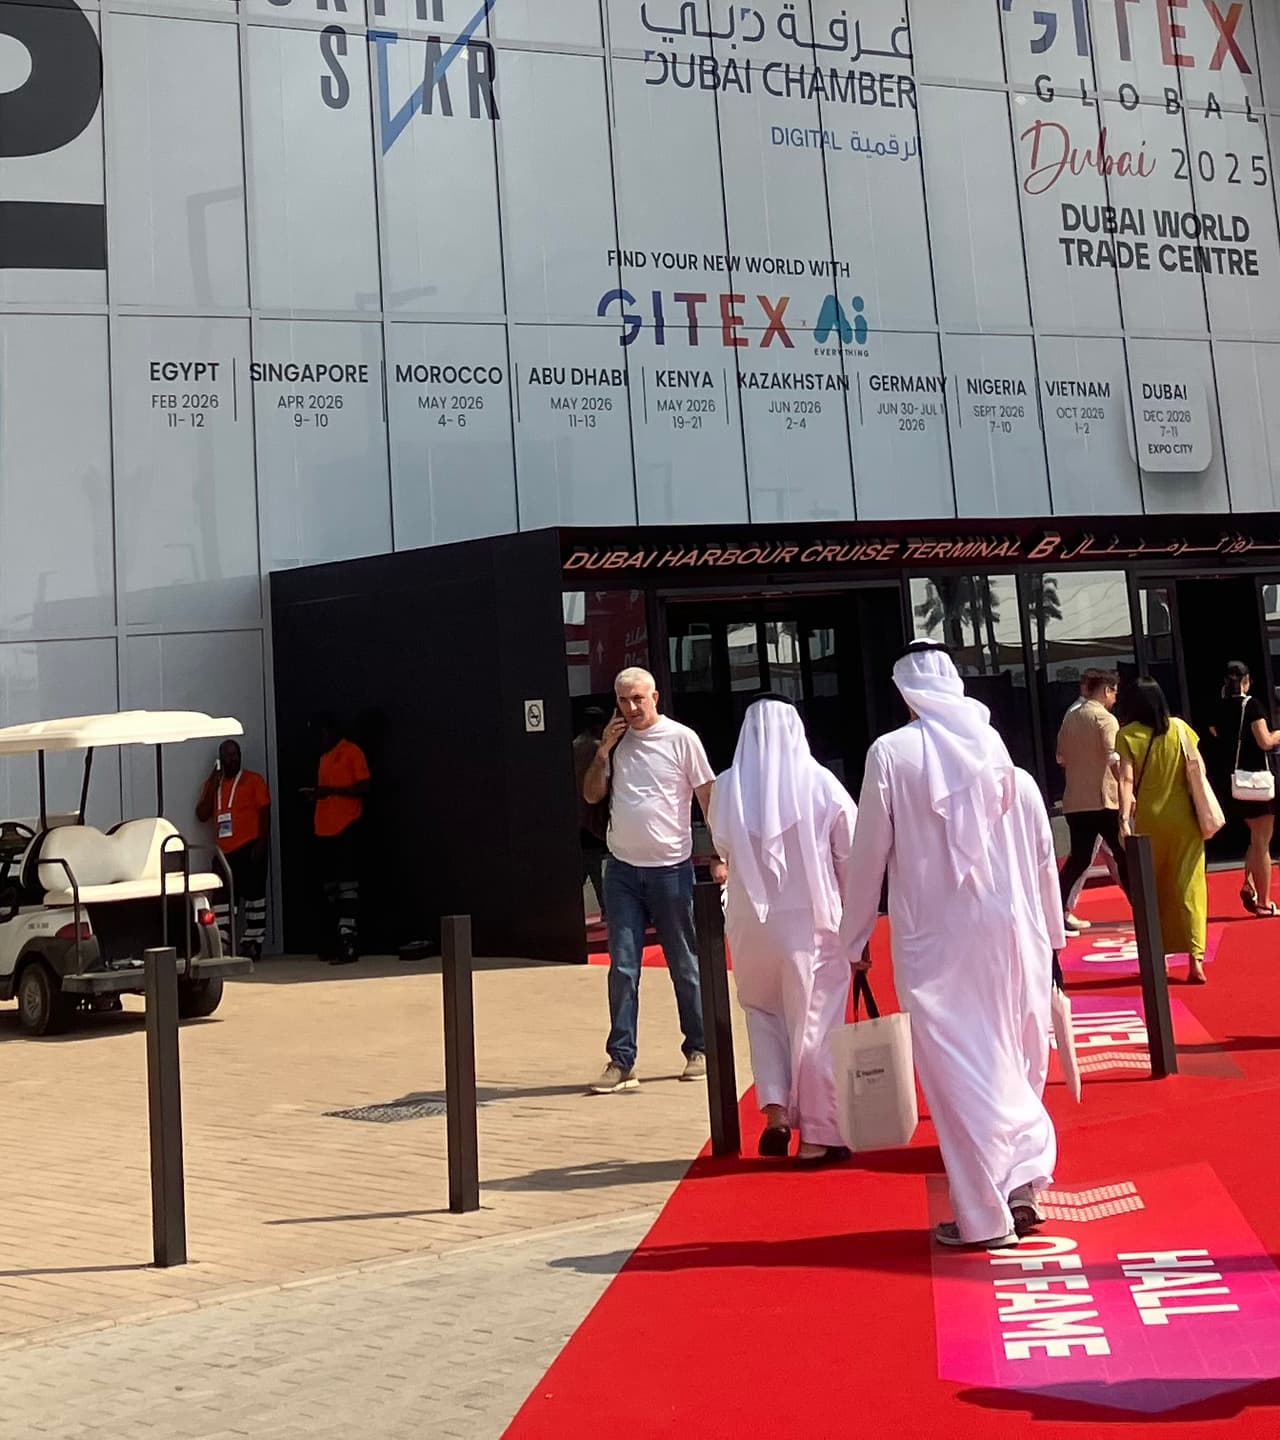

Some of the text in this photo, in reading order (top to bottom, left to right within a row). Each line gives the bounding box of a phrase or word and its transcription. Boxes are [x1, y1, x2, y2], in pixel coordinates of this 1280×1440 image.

[640, 1, 914, 63] غرفة دبي
[319, 25, 500, 152] STAR
[644, 50, 917, 110] DUBAI CHAMBER
[1034, 74, 1259, 123] GLOBAL
[771, 126, 842, 151] DIGITAL
[1020, 119, 1268, 195] Dubai 2025
[1061, 203, 1250, 242] DUBAI WORLD
[608, 249, 851, 278] FIND YOUR NEW WORLD WITH
[1059, 238, 1260, 276] TRADE CENTRE
[597, 288, 795, 349] GITEX
[814, 348, 869, 358] EVERYTHING
[150, 362, 220, 382] EGYPT
[249, 363, 369, 383] SINGAPORE
[395, 364, 503, 384] MOROCCO
[528, 367, 628, 387] ABU DHABI
[655, 370, 714, 389] KENYA
[737, 371, 850, 391] KAZAKHSTAN
[869, 375, 947, 393] GERMANY
[967, 378, 1027, 396] NIGERIA
[1045, 380, 1111, 398] VIETNAM
[1142, 383, 1188, 401] DUBAI
[151, 394, 219, 409] FEB 2026
[277, 395, 344, 409] APR 2026
[418, 396, 484, 410] MAY 2026
[550, 397, 613, 411] MAY 2026
[657, 399, 716, 413] MAY 2026
[768, 401, 821, 414] JUN 2026
[877, 402, 898, 415] JUN
[973, 405, 1025, 418] SEPT 2026
[1056, 407, 1105, 420] OCT 2026
[1144, 410, 1192, 423] DEC 2026
[568, 414, 597, 428] 11-13
[672, 415, 702, 429] 19-21
[786, 417, 807, 430] 2-4
[899, 418, 926, 431] 2026
[990, 421, 1012, 433] 7-10
[1074, 422, 1091, 435] 1-2
[1148, 444, 1193, 455] EXPO CITY
[563, 536, 1062, 570] DUBAI HARBOUR CRUISE TERMINAL B
[1116, 1248, 1240, 1326] HALL
[993, 1274, 1112, 1360] FAME
